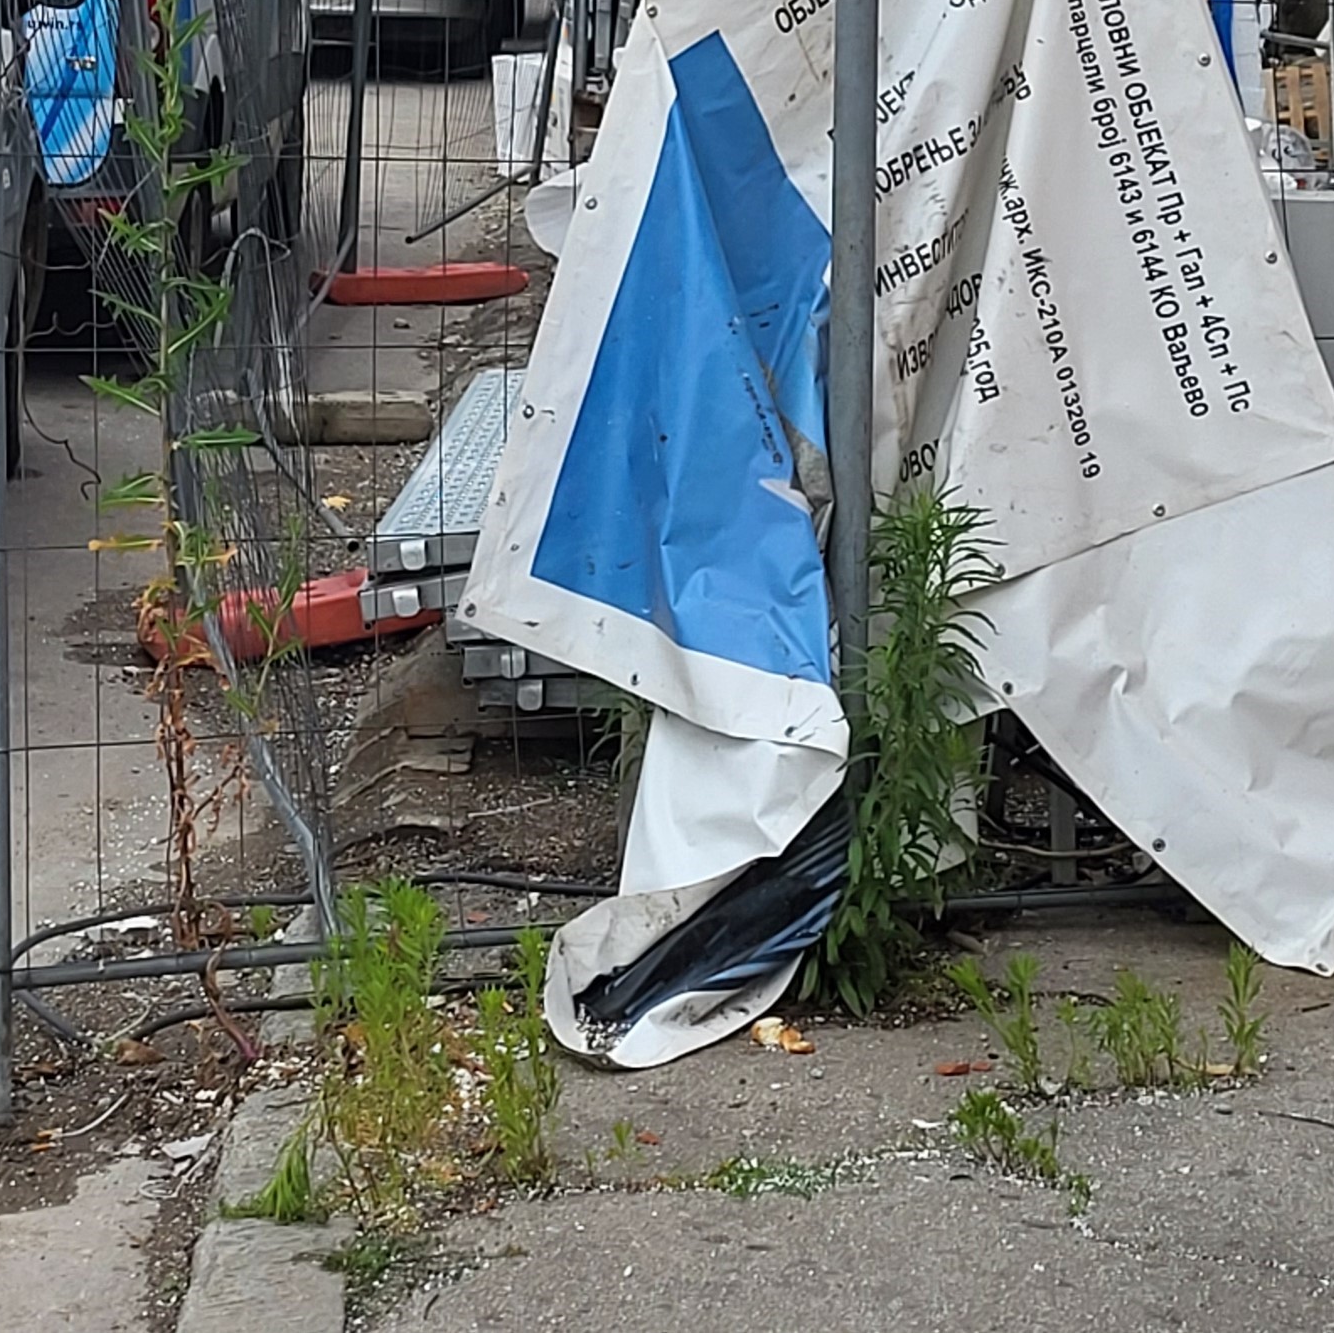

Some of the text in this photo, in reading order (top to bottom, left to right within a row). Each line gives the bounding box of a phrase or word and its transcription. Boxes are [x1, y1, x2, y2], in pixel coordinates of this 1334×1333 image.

[1090, 97, 1128, 150] број
[1124, 82, 1177, 186] ОБЈЕКАТ
[875, 127, 968, 203] ОБРЕЊЕ
[1109, 151, 1143, 205] 6143
[1125, 209, 1145, 227] и
[1156, 191, 1186, 226] Пр
[1131, 229, 1168, 282] 6144
[1173, 229, 1192, 245] +
[1175, 247, 1205, 291] Гал
[1149, 284, 1180, 318] КО
[1195, 294, 1215, 309] +
[1200, 315, 1231, 358] 4Сп
[1162, 322, 1209, 418] Ваљево
[1220, 362, 1239, 377] +
[1223, 379, 1251, 414] Пс
[1056, 366, 1091, 447] 013200
[1079, 451, 1101, 479] 19
